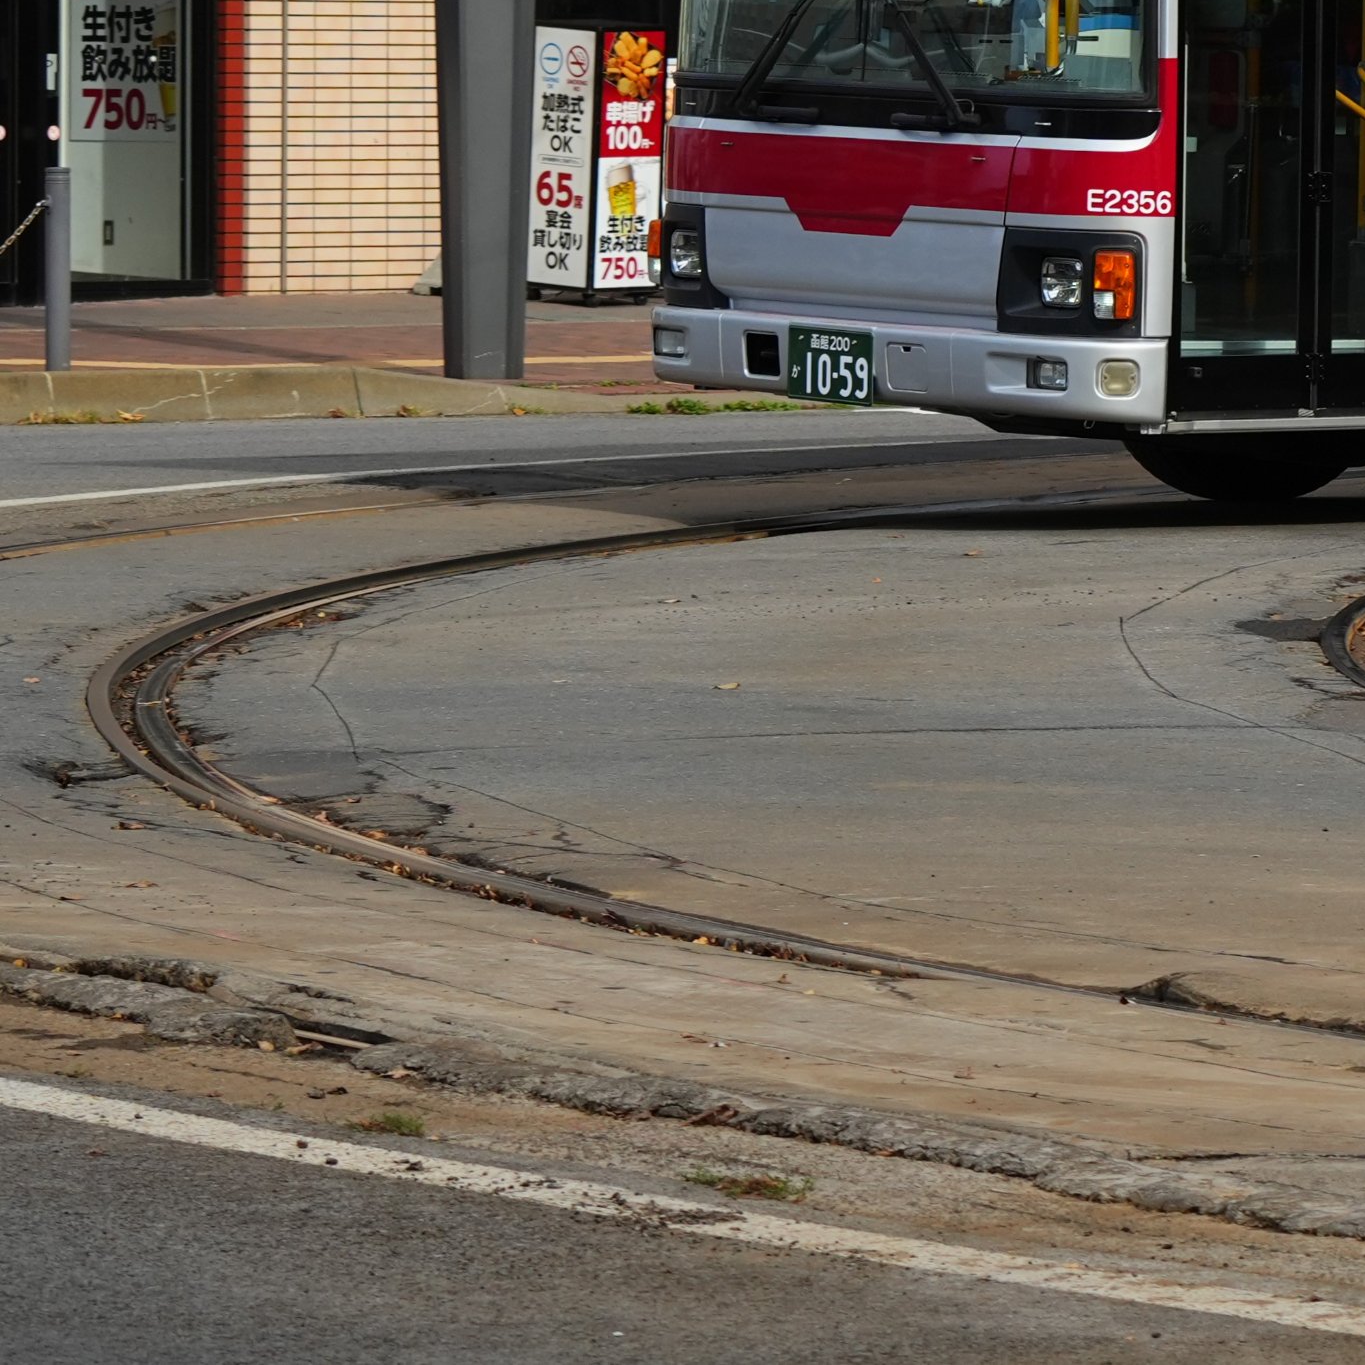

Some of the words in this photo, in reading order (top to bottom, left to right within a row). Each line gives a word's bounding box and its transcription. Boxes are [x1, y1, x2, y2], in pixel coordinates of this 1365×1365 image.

[81, 5, 155, 43] 生付き
[541, 114, 583, 134] たばこ
[550, 134, 573, 153] OK
[1086, 188, 1172, 215] E2356
[545, 210, 572, 230] 宴会
[606, 215, 646, 235] 生付き
[532, 228, 583, 251] 貸し切り
[545, 251, 569, 271] OK
[805, 351, 869, 400] 10-59
